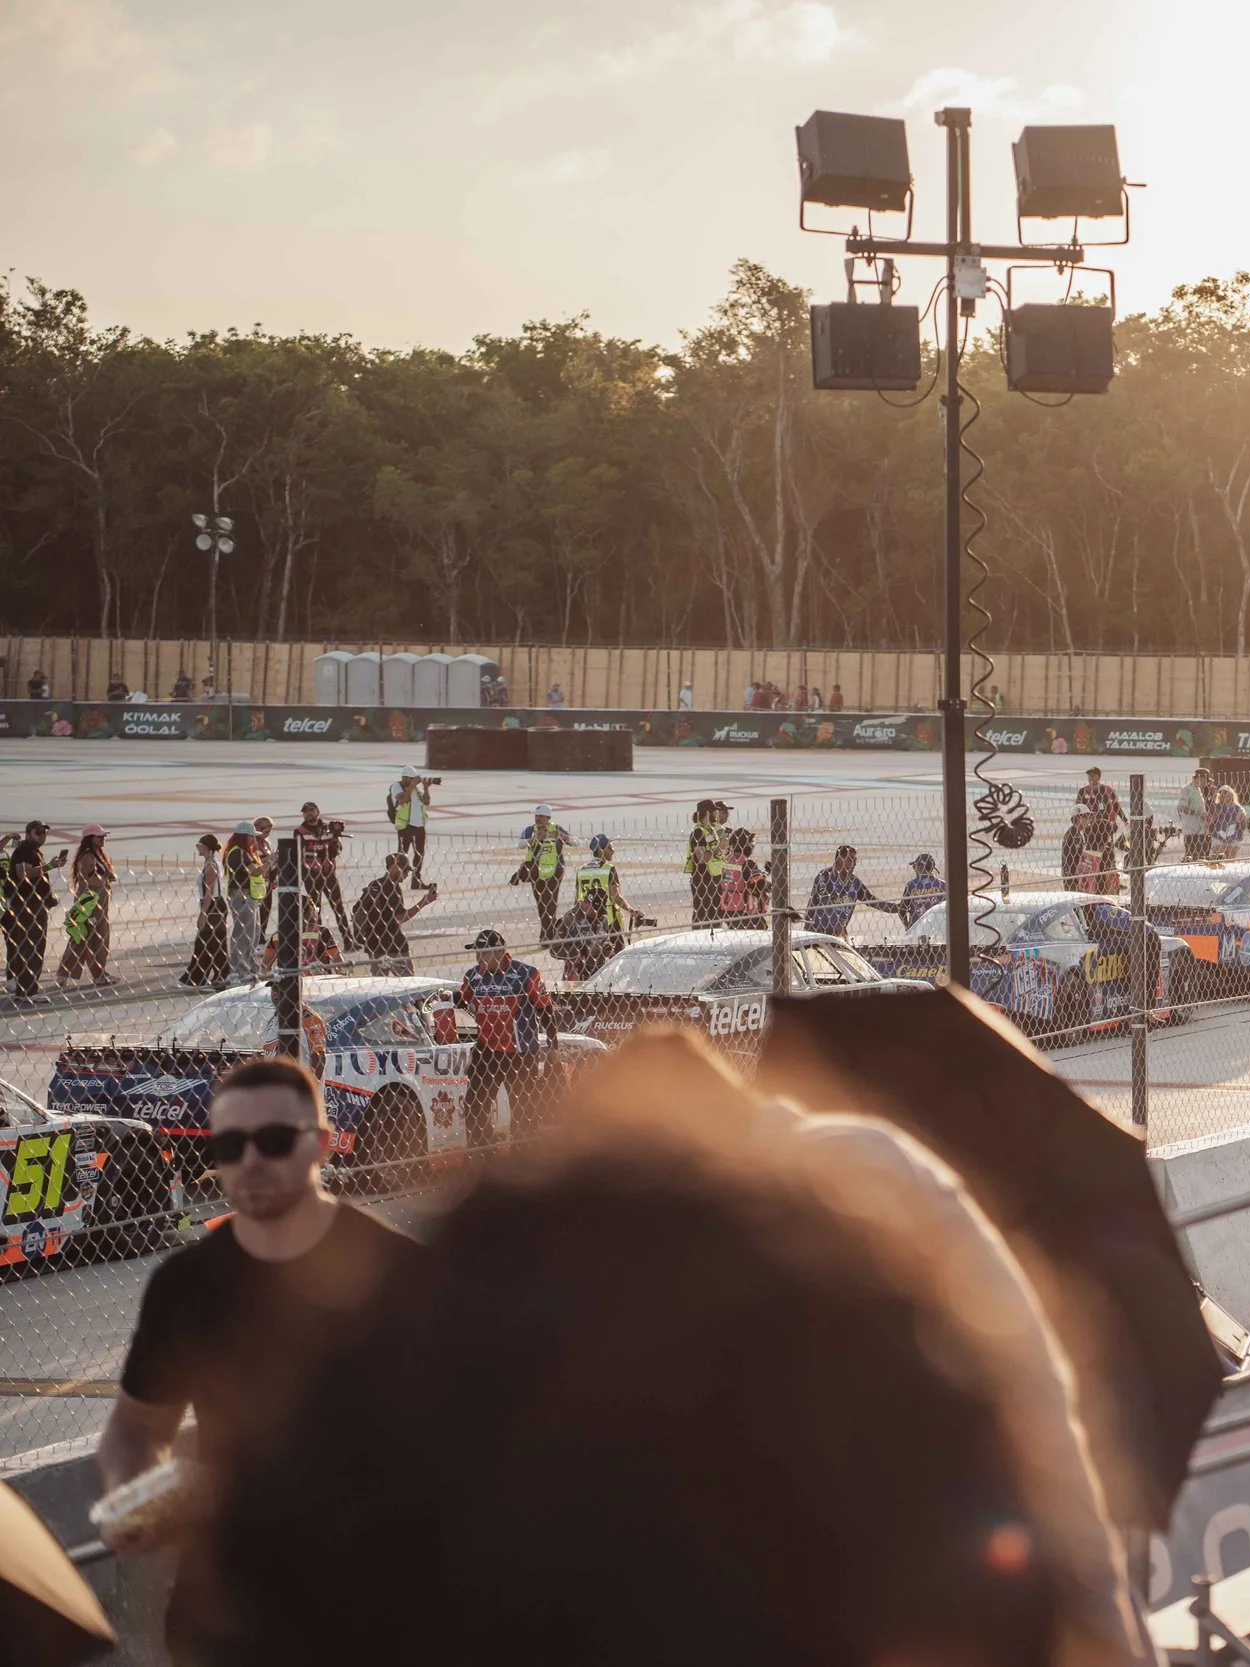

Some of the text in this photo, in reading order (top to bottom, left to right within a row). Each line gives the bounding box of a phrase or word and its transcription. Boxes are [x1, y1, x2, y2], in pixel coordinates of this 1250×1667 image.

[283, 717, 332, 733] telcel
[853, 725, 896, 738] Aurora
[984, 729, 1028, 746] telcel
[709, 994, 766, 1036] telcel
[594, 1021, 633, 1031] RUCKUS
[333, 1048, 470, 1076] TOYOPOW
[133, 1100, 188, 1121] telcel
[6, 1133, 72, 1216] 51
